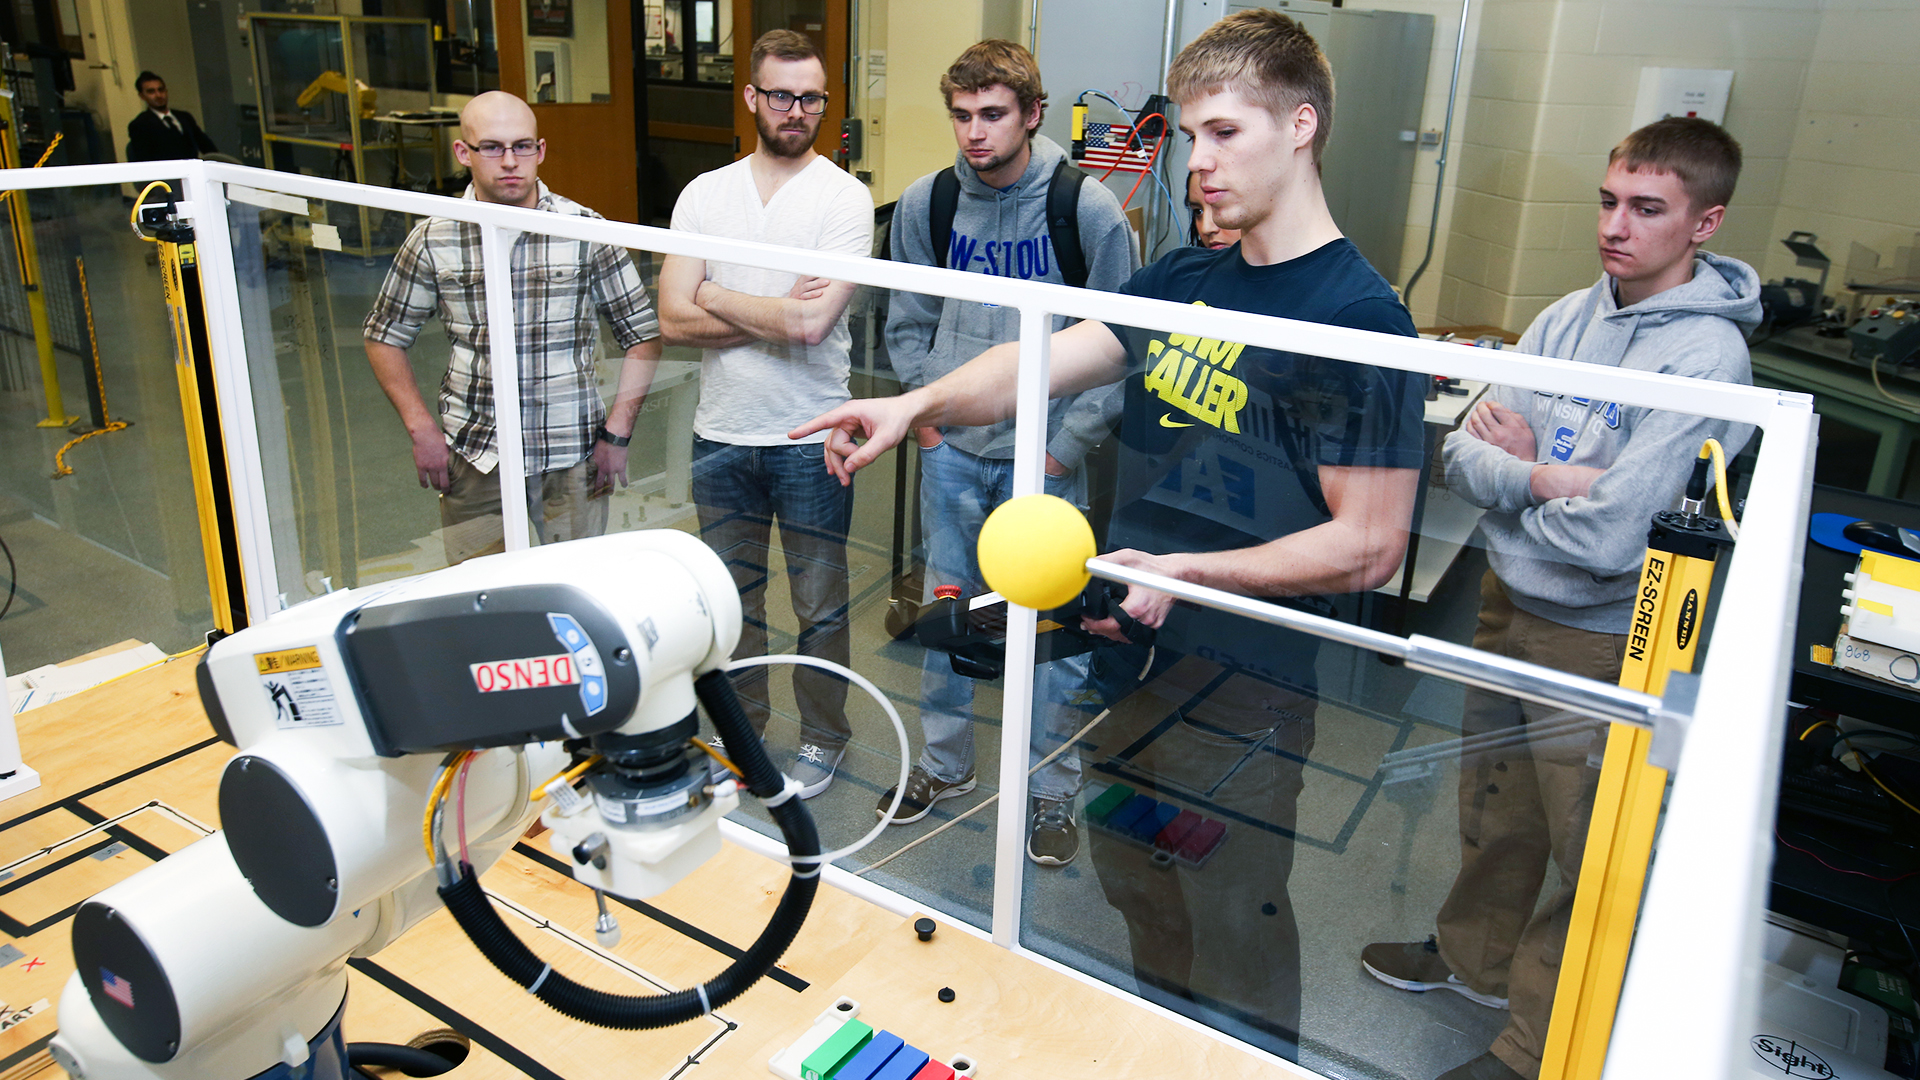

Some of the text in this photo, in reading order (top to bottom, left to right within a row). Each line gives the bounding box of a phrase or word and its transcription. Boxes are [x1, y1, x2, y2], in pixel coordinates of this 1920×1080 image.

[157, 243, 172, 300] EZ-SCREEN
[1144, 339, 1249, 435] CALLER
[1628, 556, 1665, 661] EZ-SCREEN
[1680, 591, 1696, 648] BANNER
[476, 656, 573, 693] DENSO
[1844, 644, 1871, 662] 868
[1757, 1038, 1828, 1077] Sight
